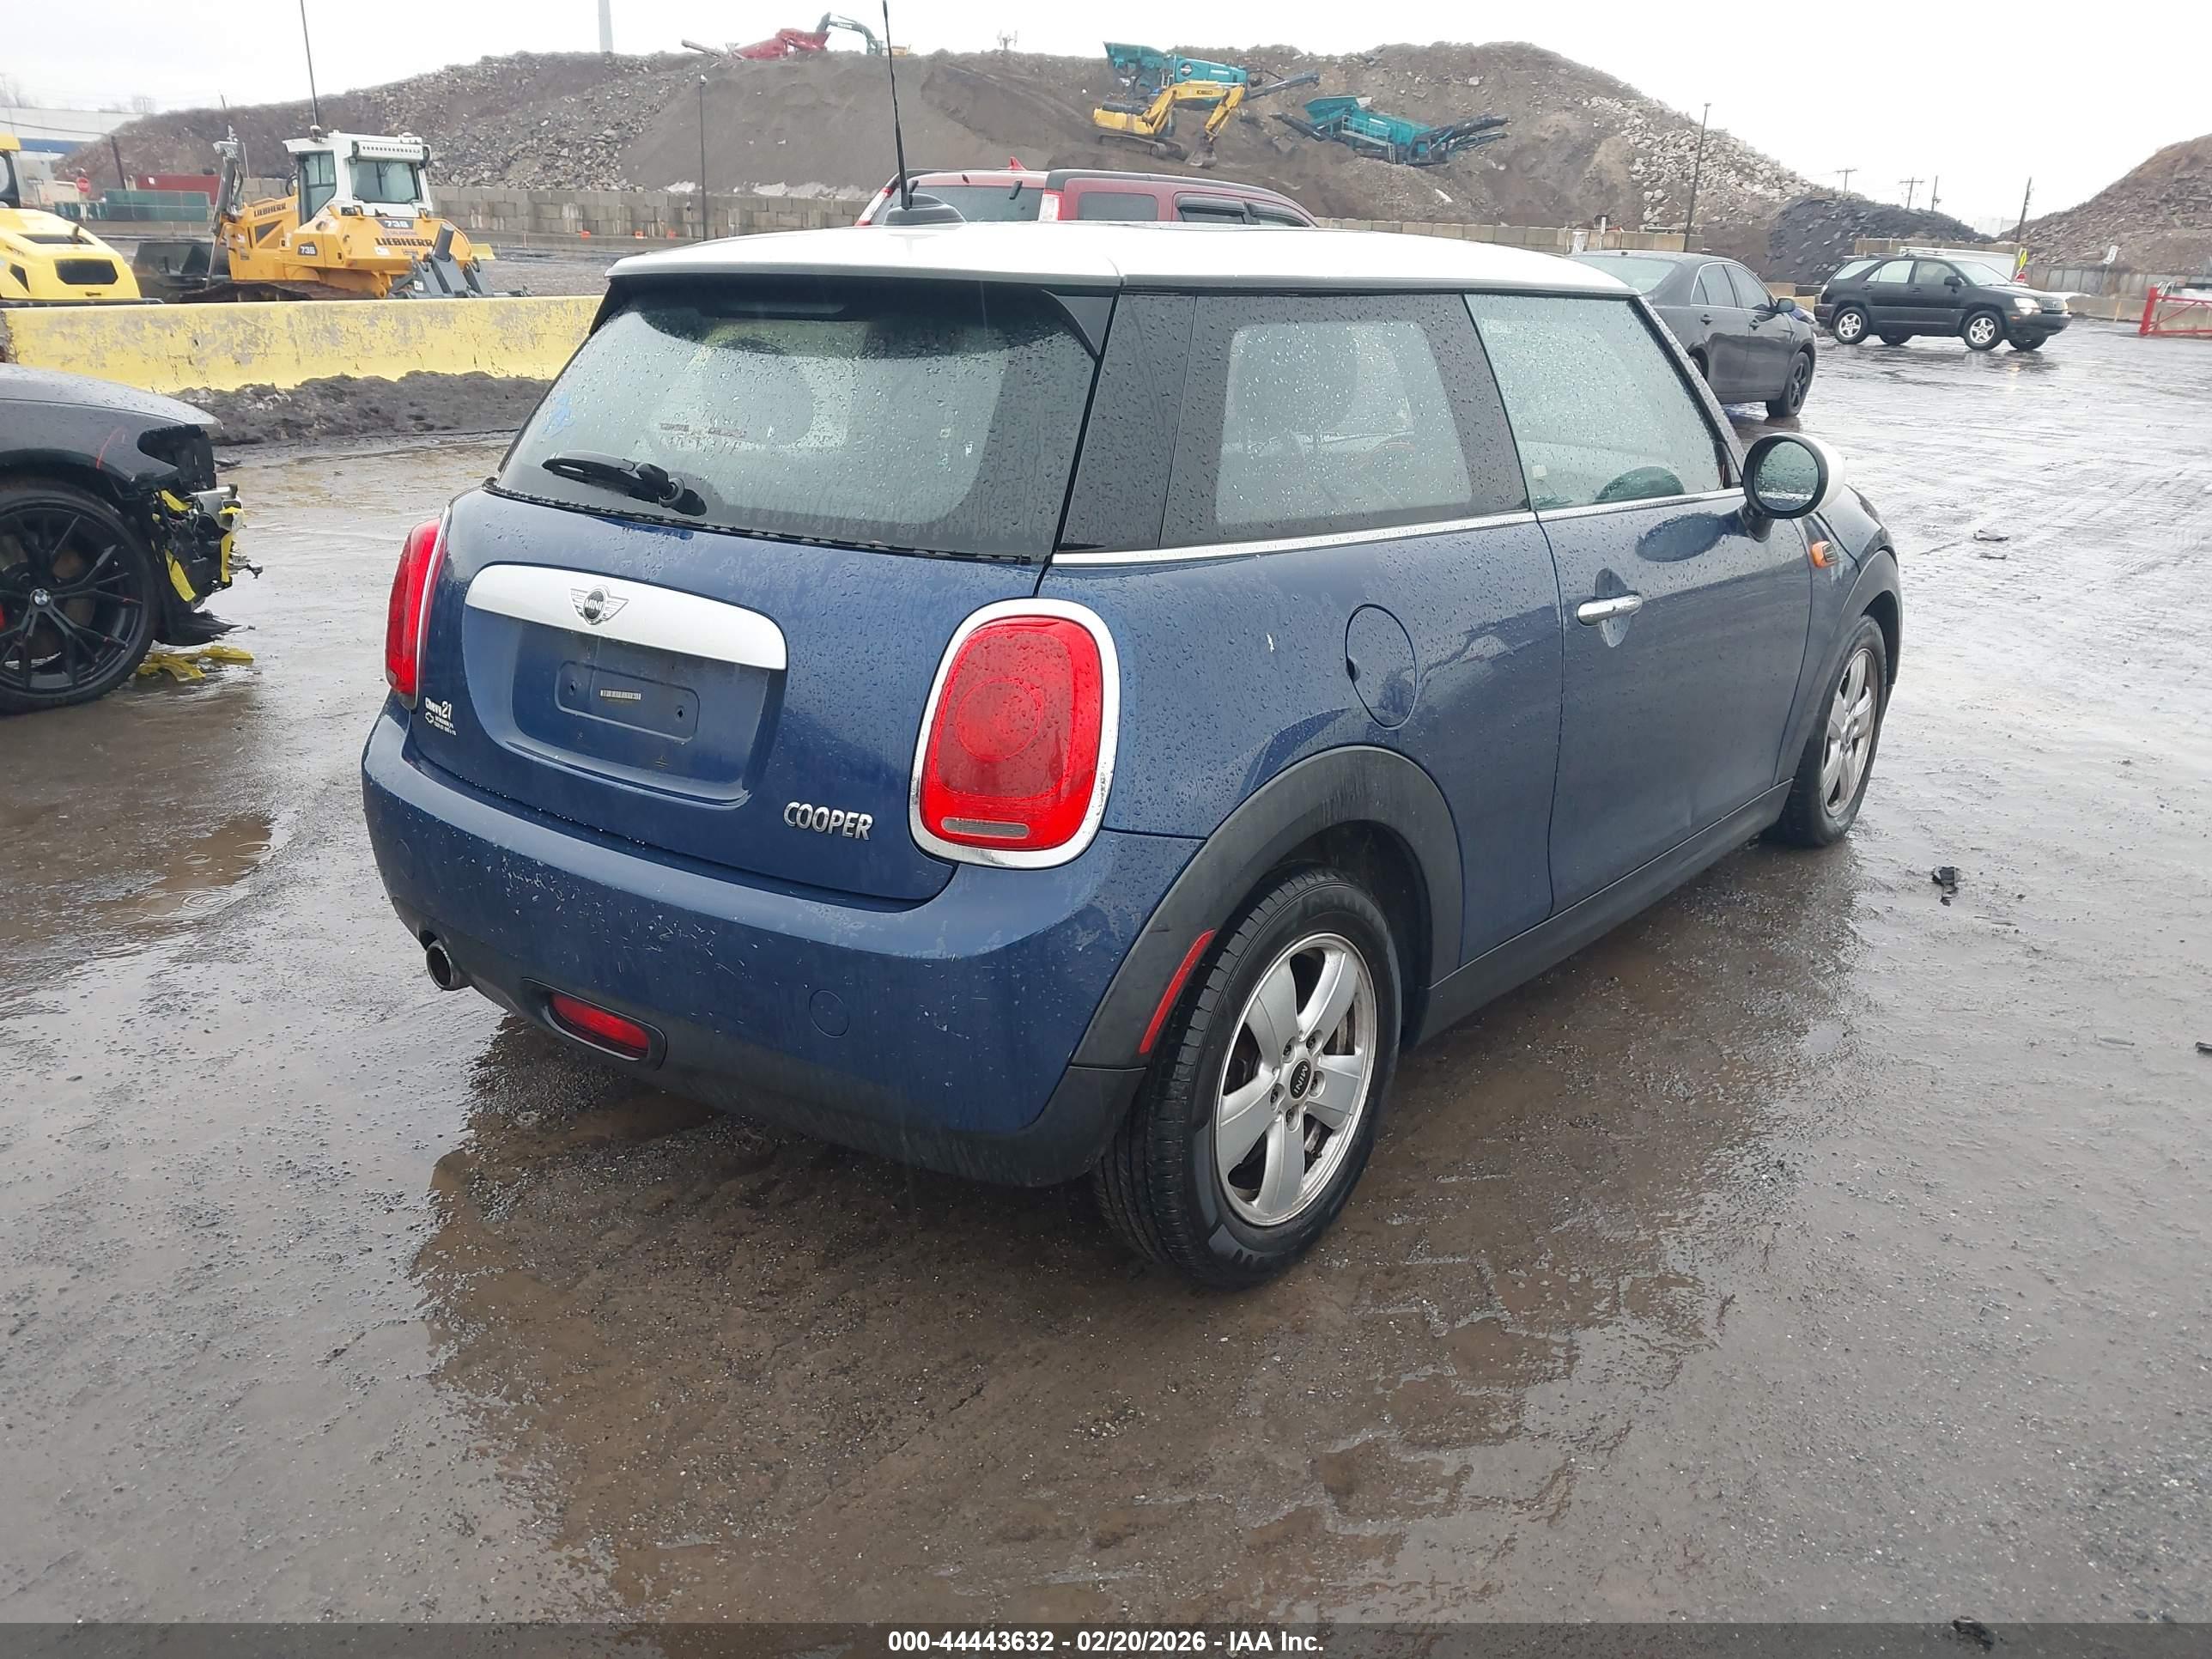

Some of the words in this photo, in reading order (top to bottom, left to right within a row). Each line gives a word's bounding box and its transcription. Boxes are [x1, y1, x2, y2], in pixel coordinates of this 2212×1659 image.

[253, 203, 287, 217] LIEBHERR
[374, 238, 434, 247] LIEBHERR
[585, 598, 604, 611] MINI
[783, 801, 873, 841] COOPER
[1293, 1065, 1309, 1094] MINI
